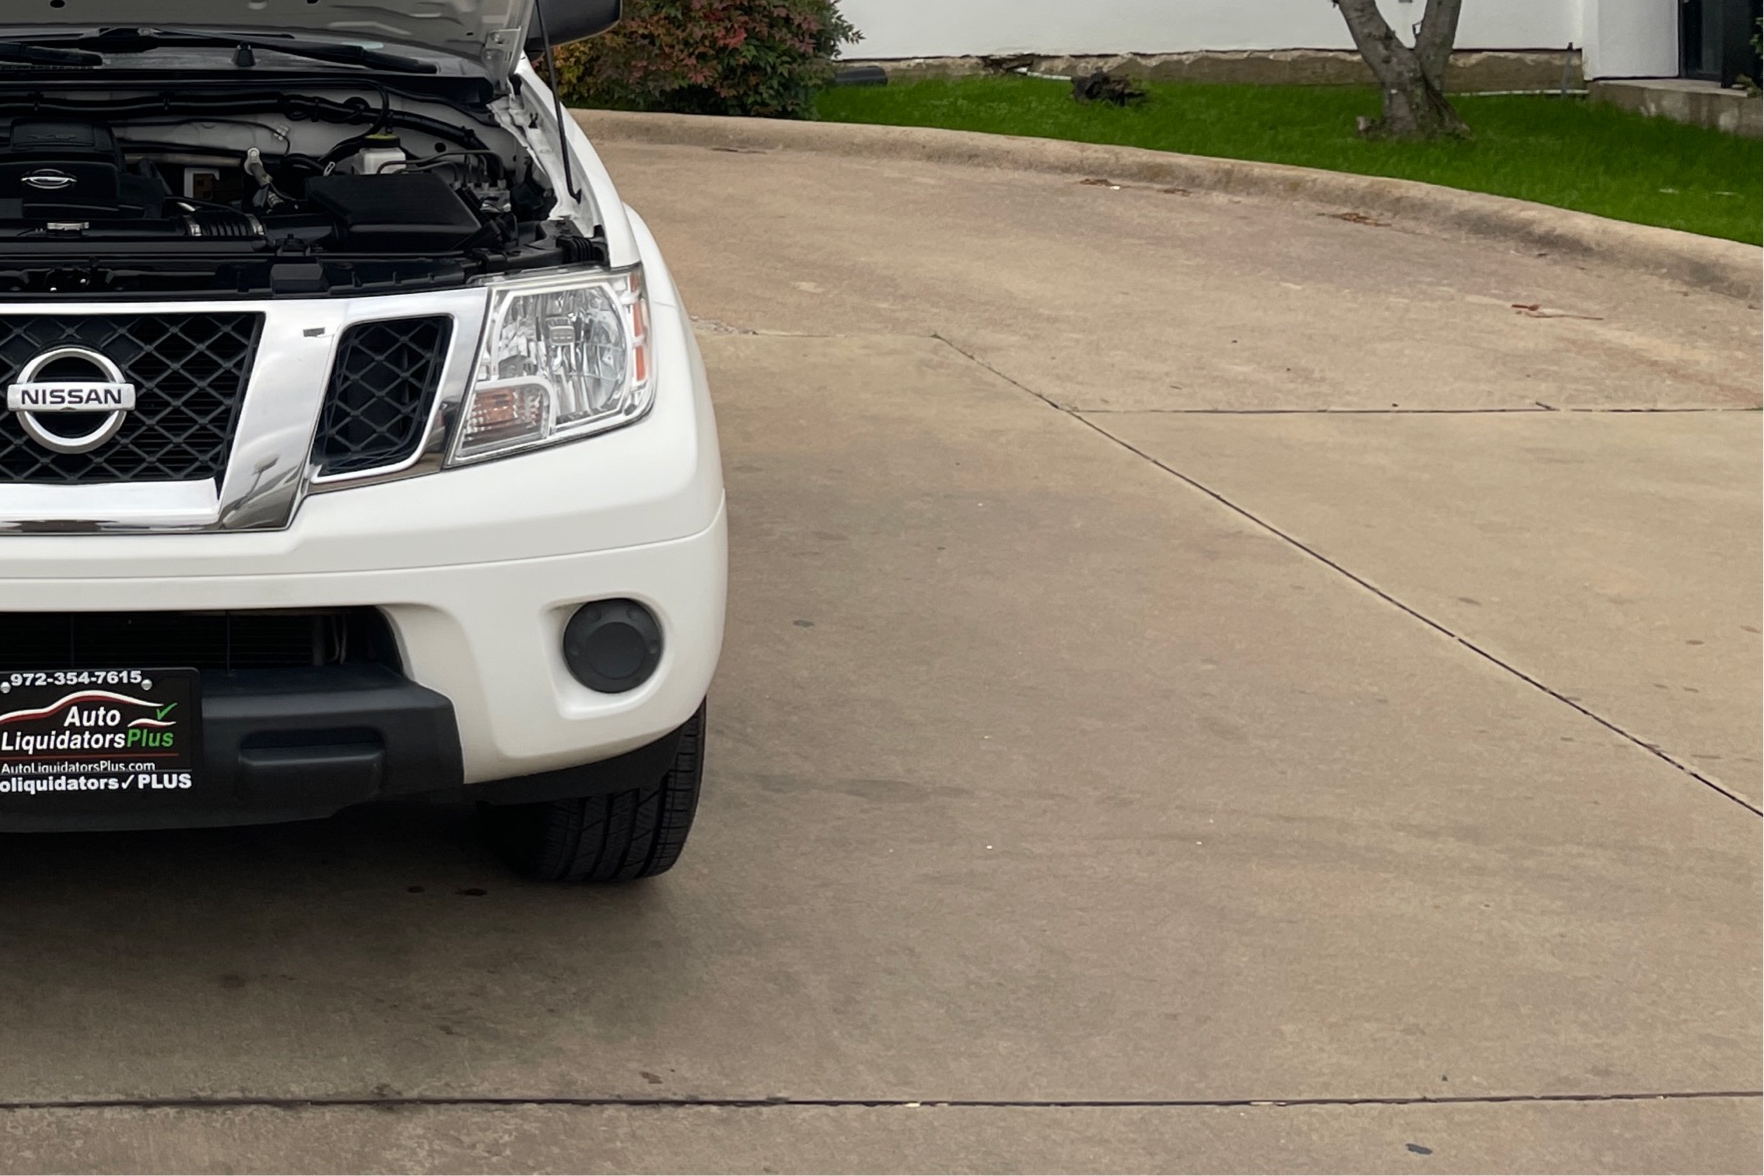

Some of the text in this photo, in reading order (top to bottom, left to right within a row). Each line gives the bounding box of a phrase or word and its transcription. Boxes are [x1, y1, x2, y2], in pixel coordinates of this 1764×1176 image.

[21, 389, 122, 404] NISSAN
[10, 671, 142, 686] 972-354-7615
[64, 706, 121, 727] Auto
[1, 760, 156, 774] AutoLiquidatorsPlus.com
